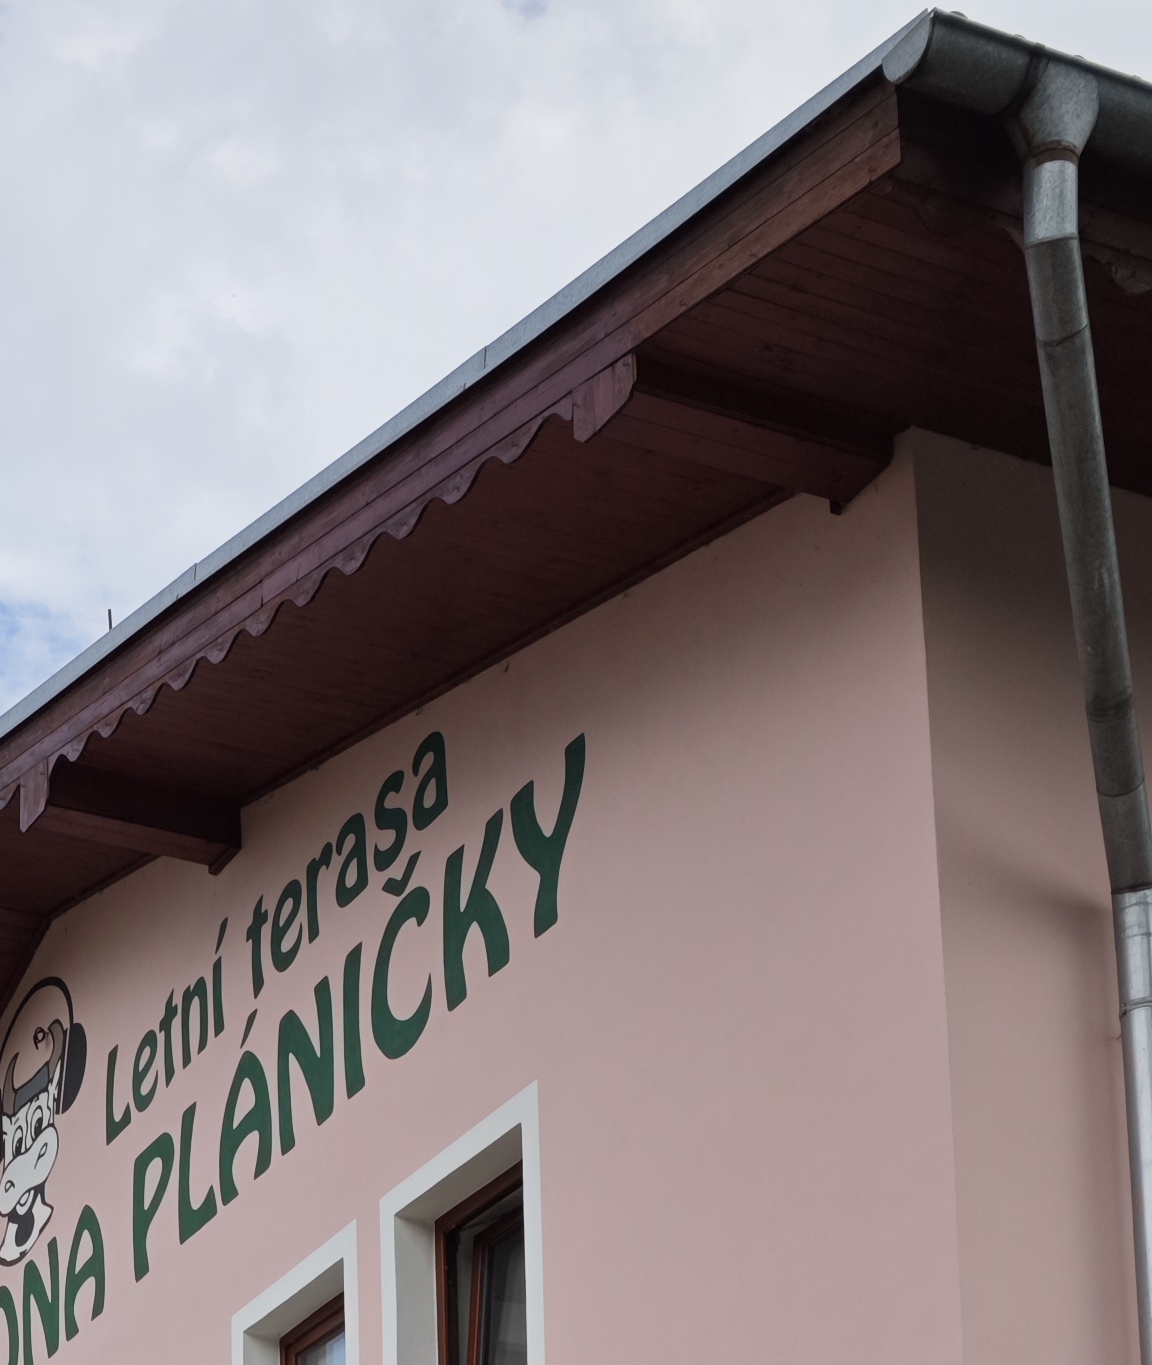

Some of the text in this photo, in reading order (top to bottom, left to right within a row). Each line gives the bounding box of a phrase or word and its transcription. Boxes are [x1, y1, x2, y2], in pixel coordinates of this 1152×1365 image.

[105, 731, 449, 1146] Letní terasa
[133, 733, 586, 1282] PLÁNIČKY
